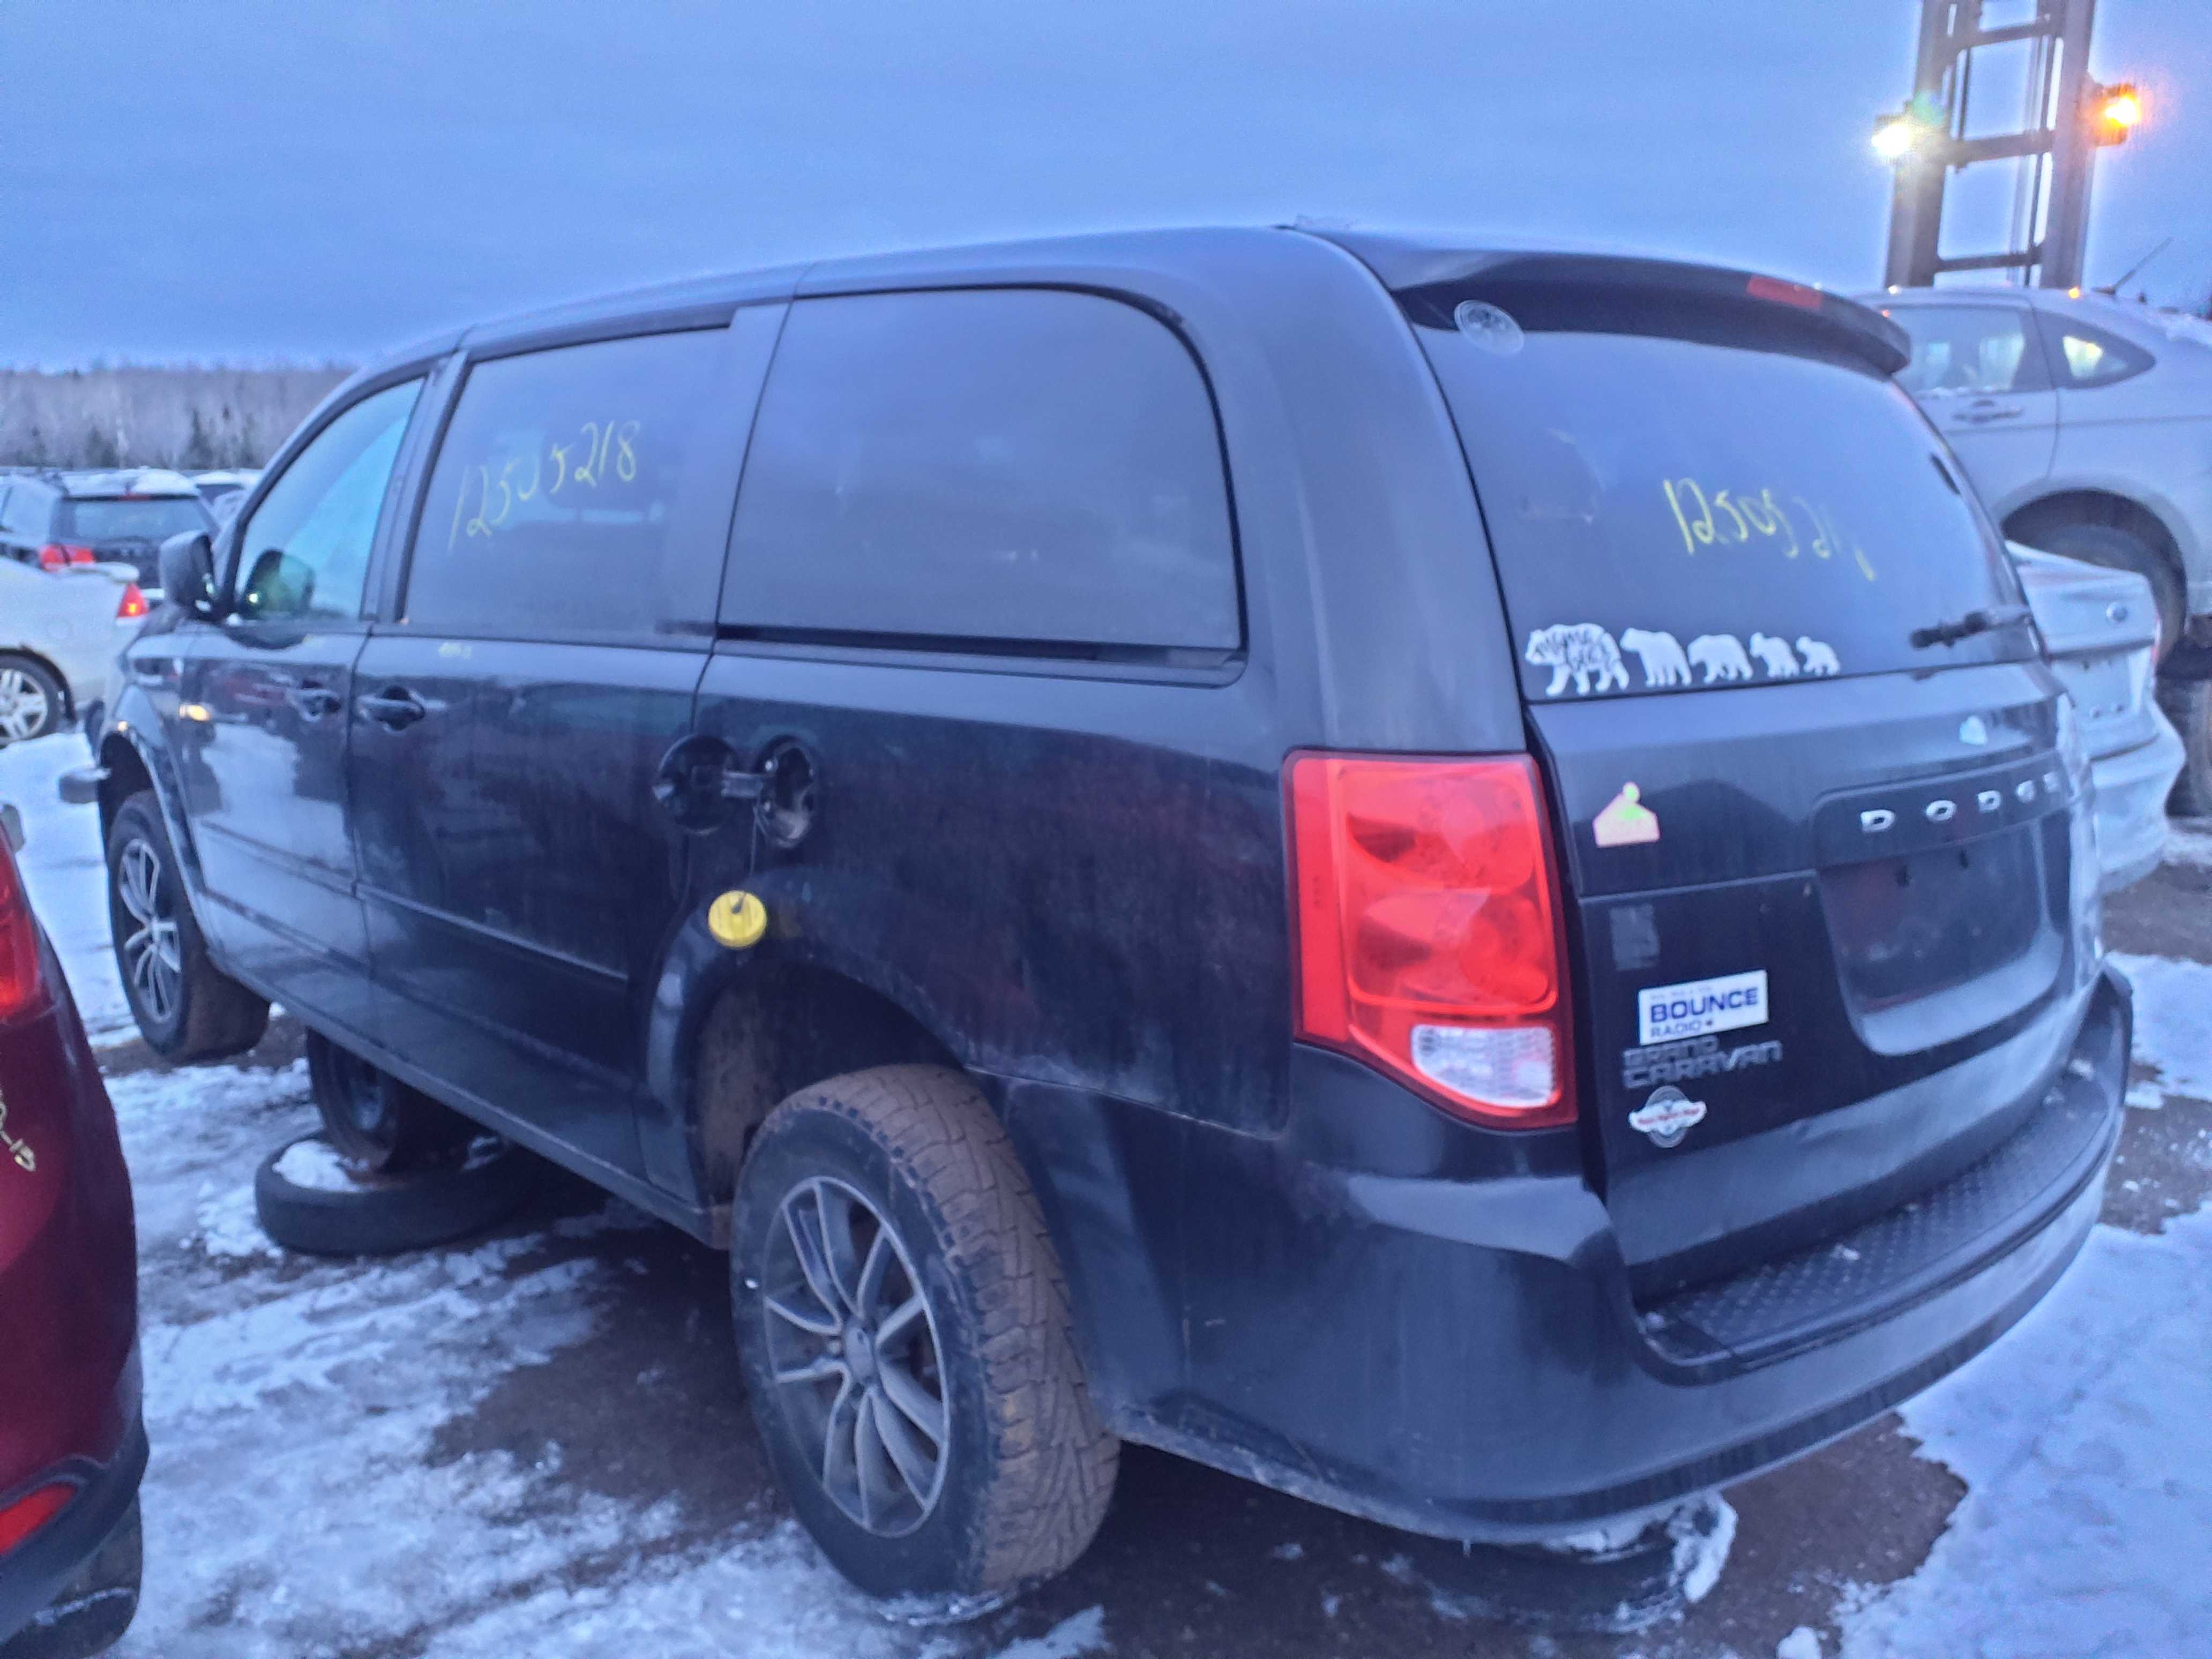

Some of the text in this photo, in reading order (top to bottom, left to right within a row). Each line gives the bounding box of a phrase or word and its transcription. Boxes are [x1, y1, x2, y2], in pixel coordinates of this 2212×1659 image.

[1651, 988, 1758, 1022] BOUNCE
[1651, 1021, 1701, 1037] RADIO
[1623, 1040, 1783, 1089] CARAVAN
